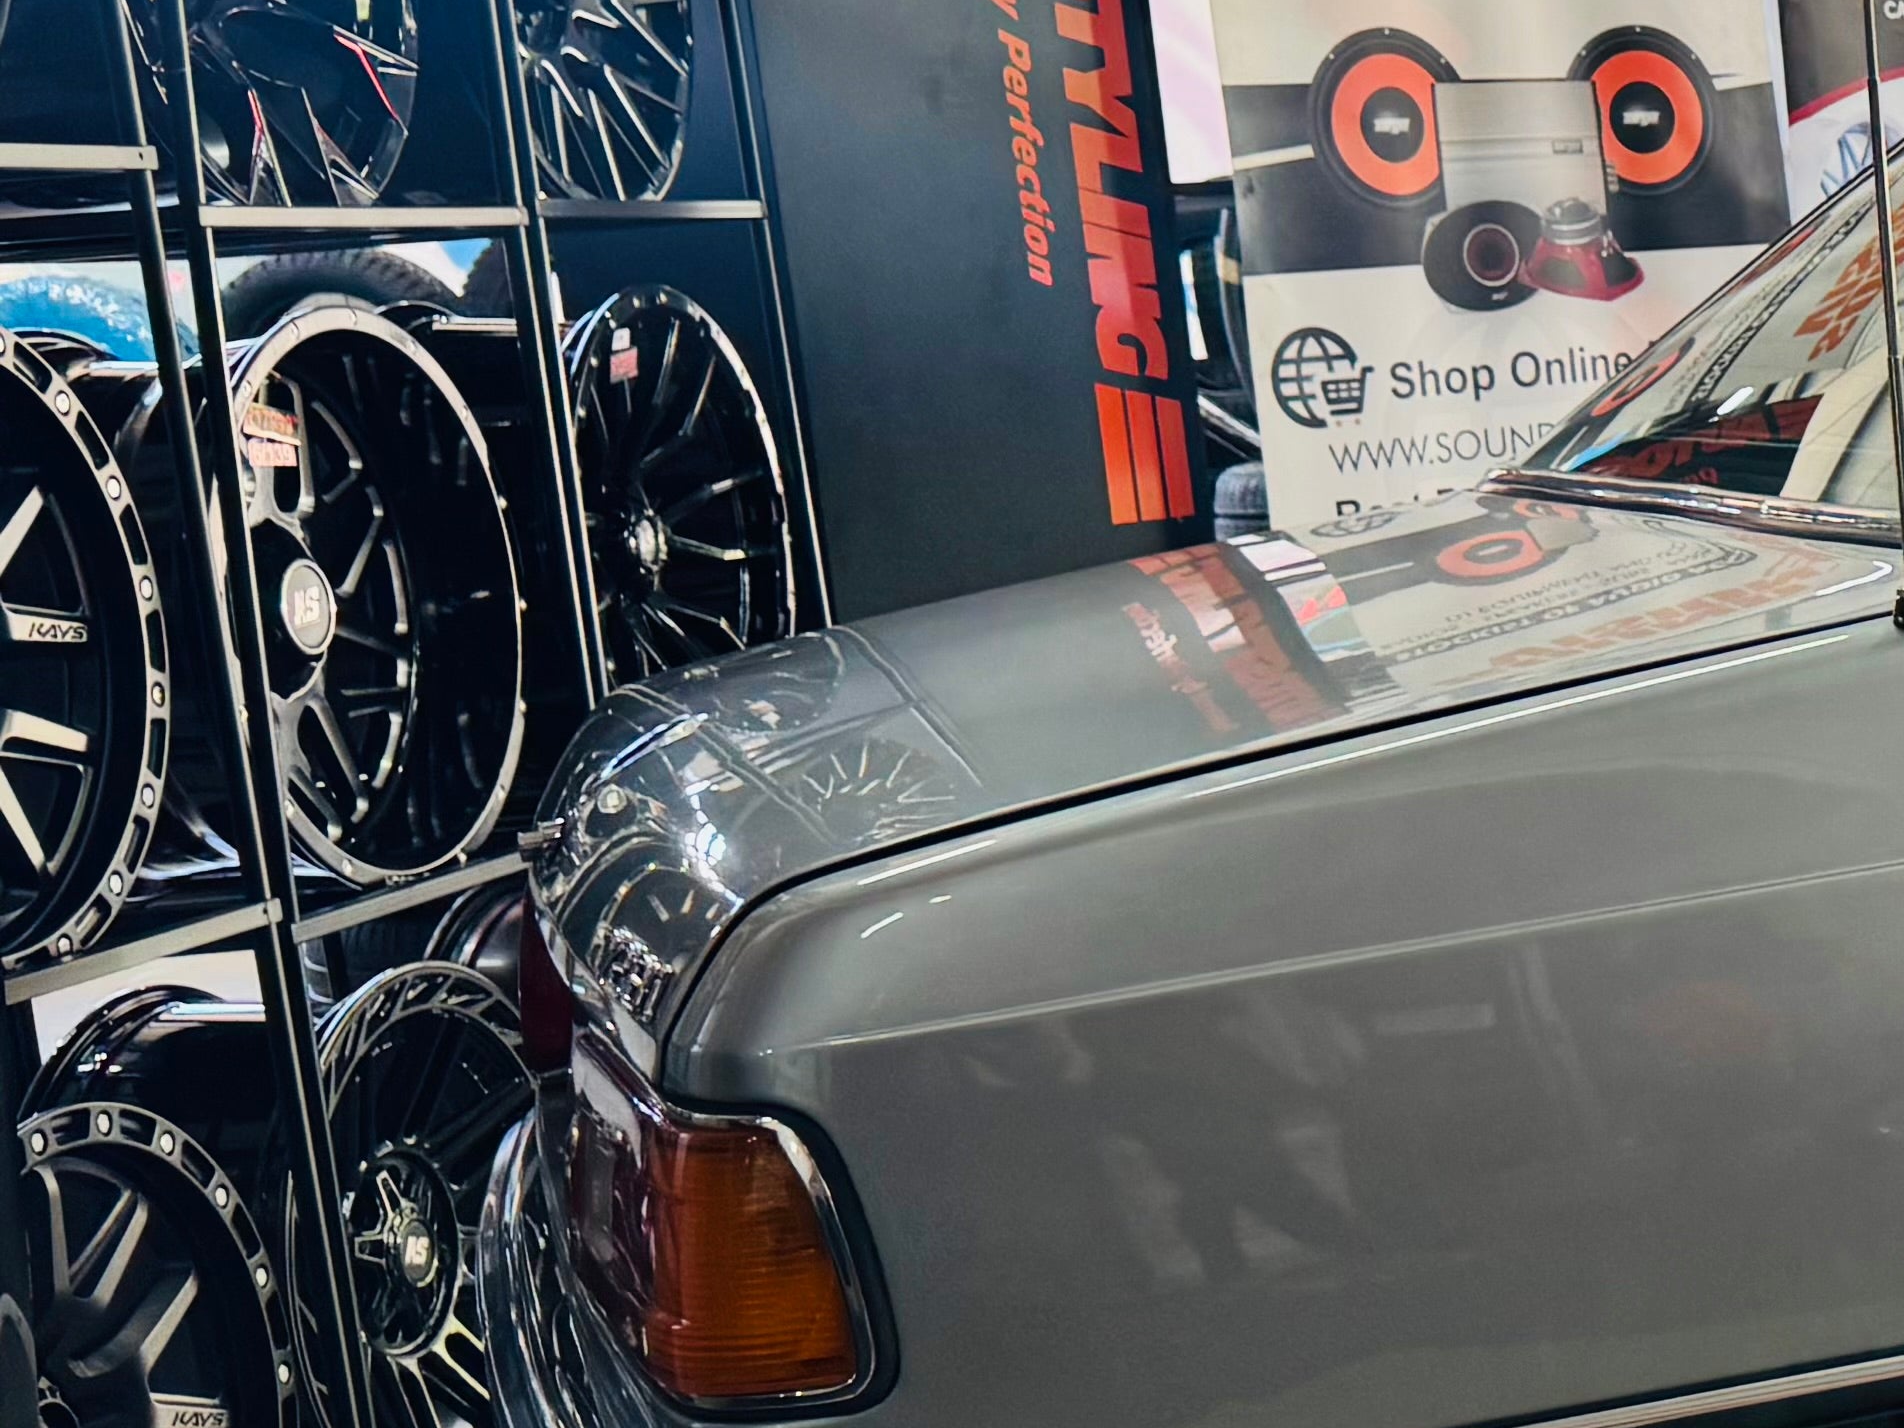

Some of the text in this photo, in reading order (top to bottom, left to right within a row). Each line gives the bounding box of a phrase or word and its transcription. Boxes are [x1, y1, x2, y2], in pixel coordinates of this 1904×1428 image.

[990, 24, 1054, 287] Perfection
[1390, 348, 1630, 401] Shop Online
